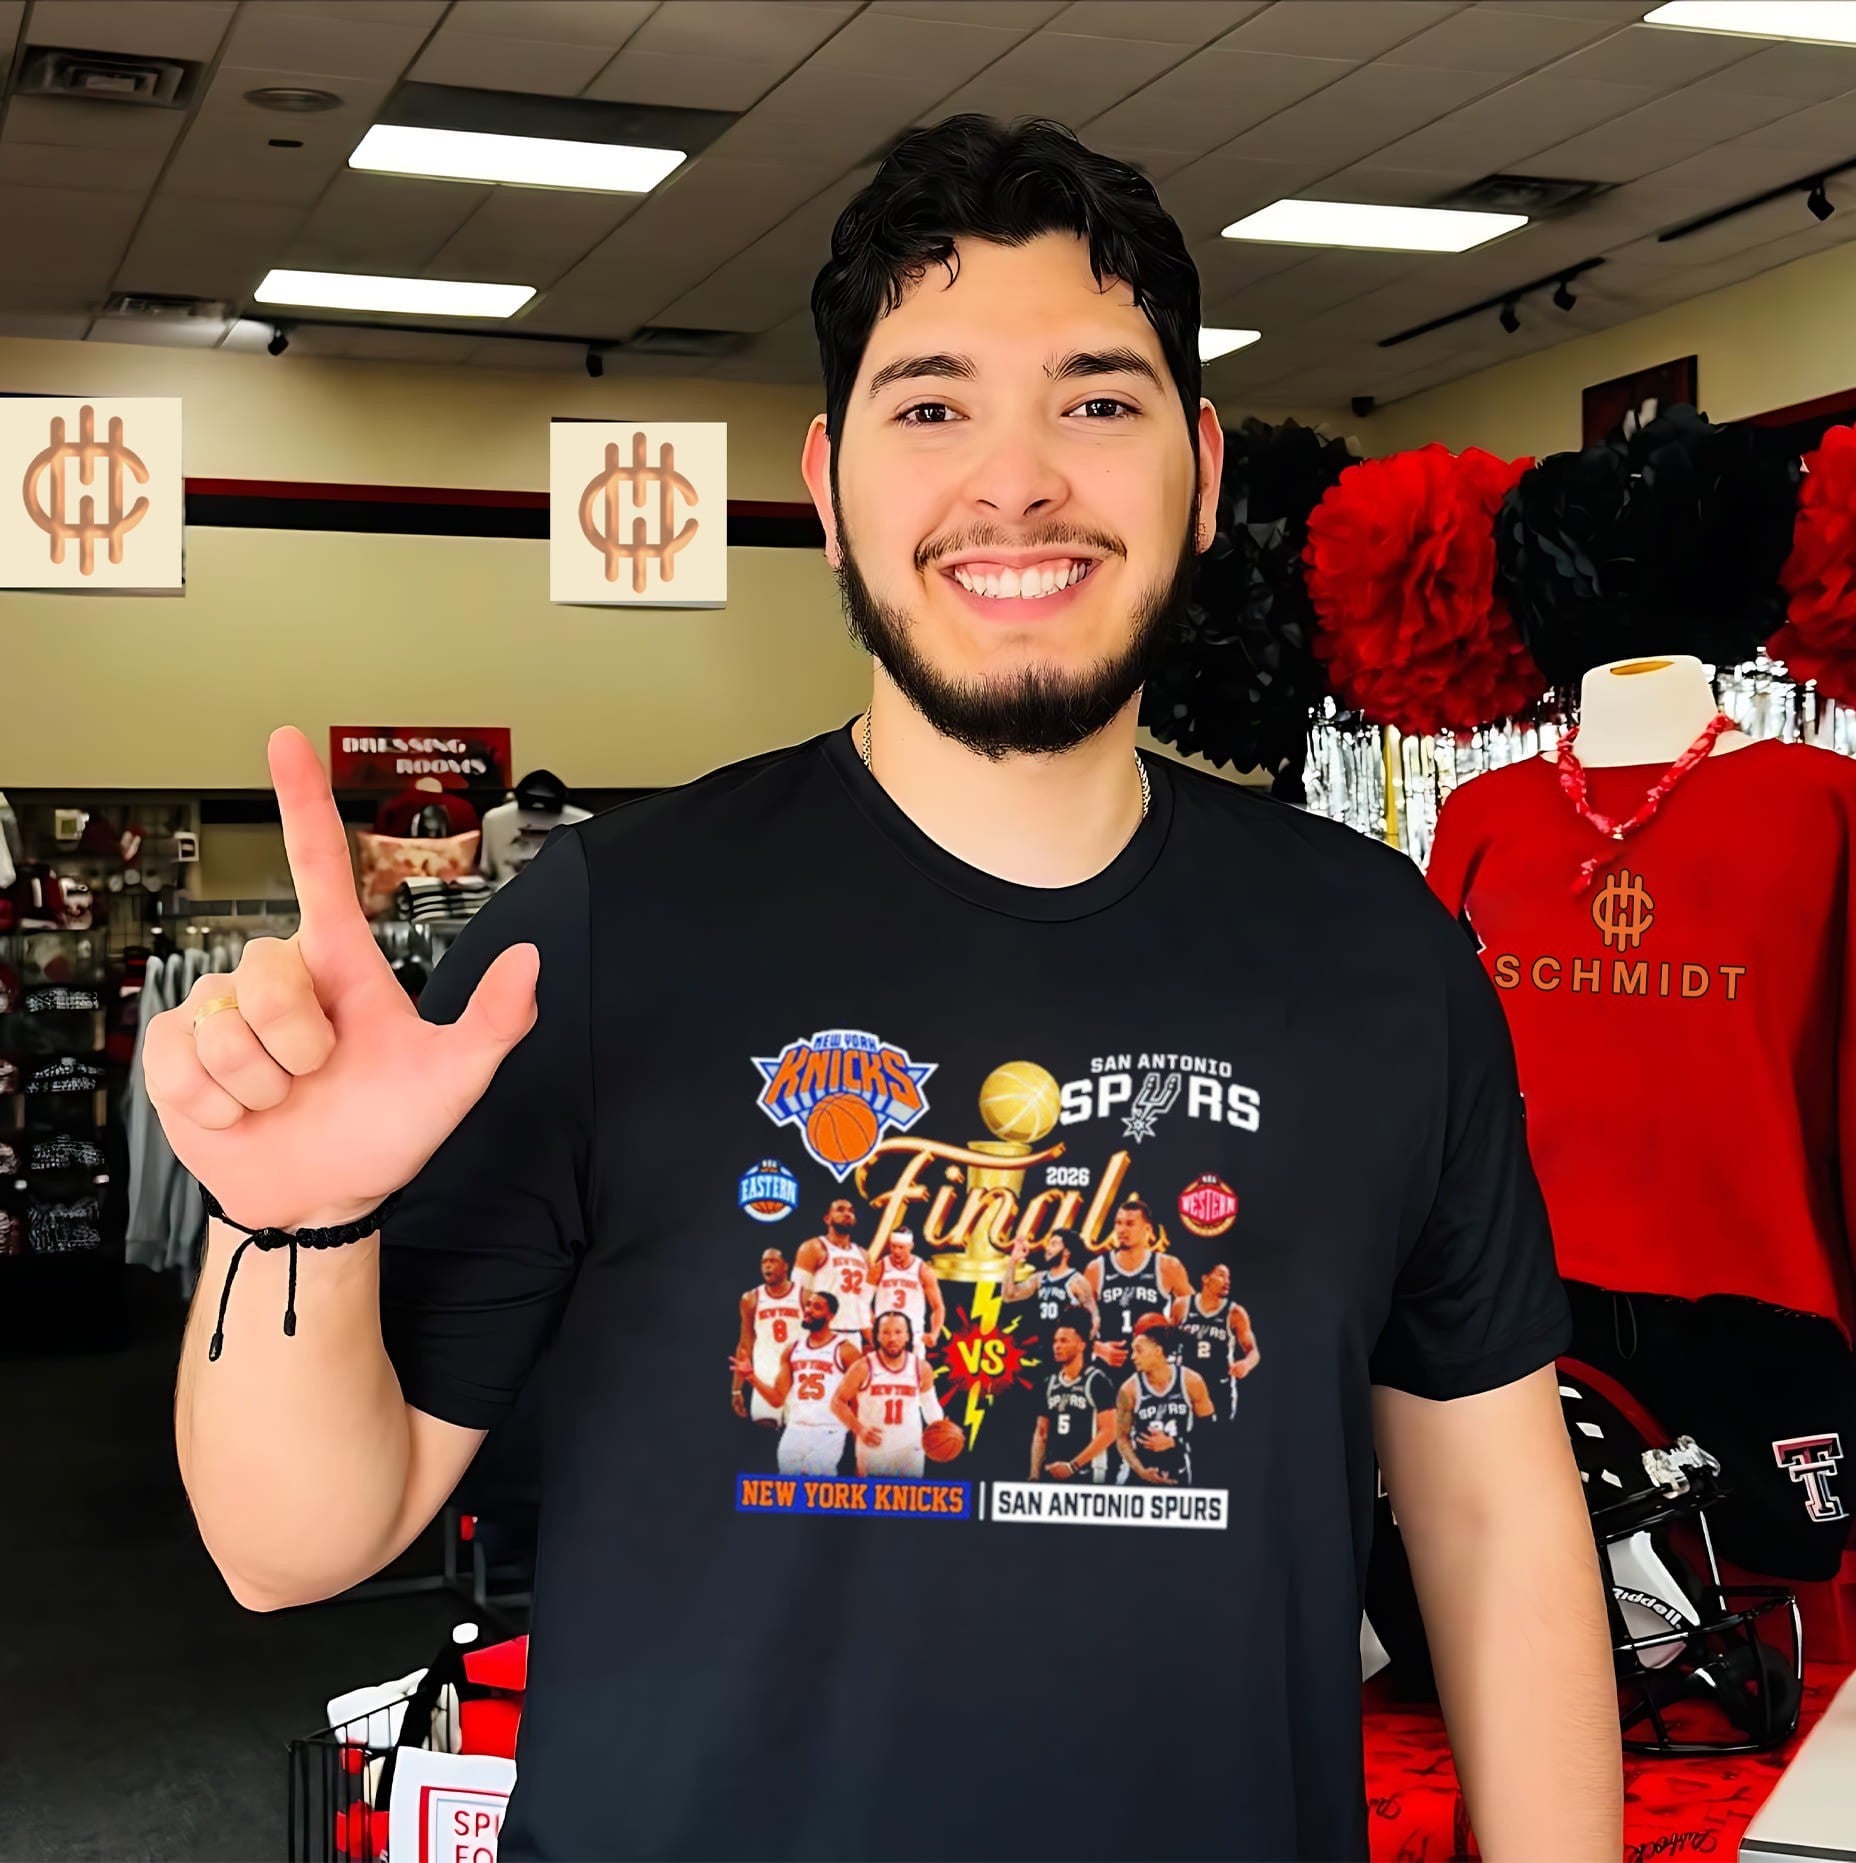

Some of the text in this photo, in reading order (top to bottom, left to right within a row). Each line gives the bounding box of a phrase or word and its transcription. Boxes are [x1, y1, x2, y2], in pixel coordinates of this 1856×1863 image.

[342, 737, 467, 754] DRESSING
[396, 758, 487, 776] ROOMS
[1494, 954, 1747, 1000] SCHMIDT
[814, 1033, 878, 1050] NEW YORK
[1090, 1053, 1233, 1078] SAN ANTONIO
[764, 1047, 923, 1111] KNICKS
[1045, 1166, 1091, 1187] 2026
[741, 1175, 797, 1204] EASTERN
[855, 1136, 1171, 1263] Final
[1181, 1189, 1236, 1221] WESTERN
[841, 1268, 863, 1295] 32
[893, 1289, 906, 1309] 3
[1039, 1301, 1059, 1320] 30
[773, 1319, 787, 1343] 8
[1121, 1310, 1133, 1333] 1
[957, 1338, 1006, 1375] VS
[1197, 1340, 1211, 1358] 2
[798, 1374, 825, 1400] 25
[884, 1399, 903, 1425] 11
[1057, 1414, 1071, 1434] 5
[741, 1479, 964, 1513] NEW YORK KNICKS
[998, 1490, 1222, 1521] SAN ANTONIO SPURS
